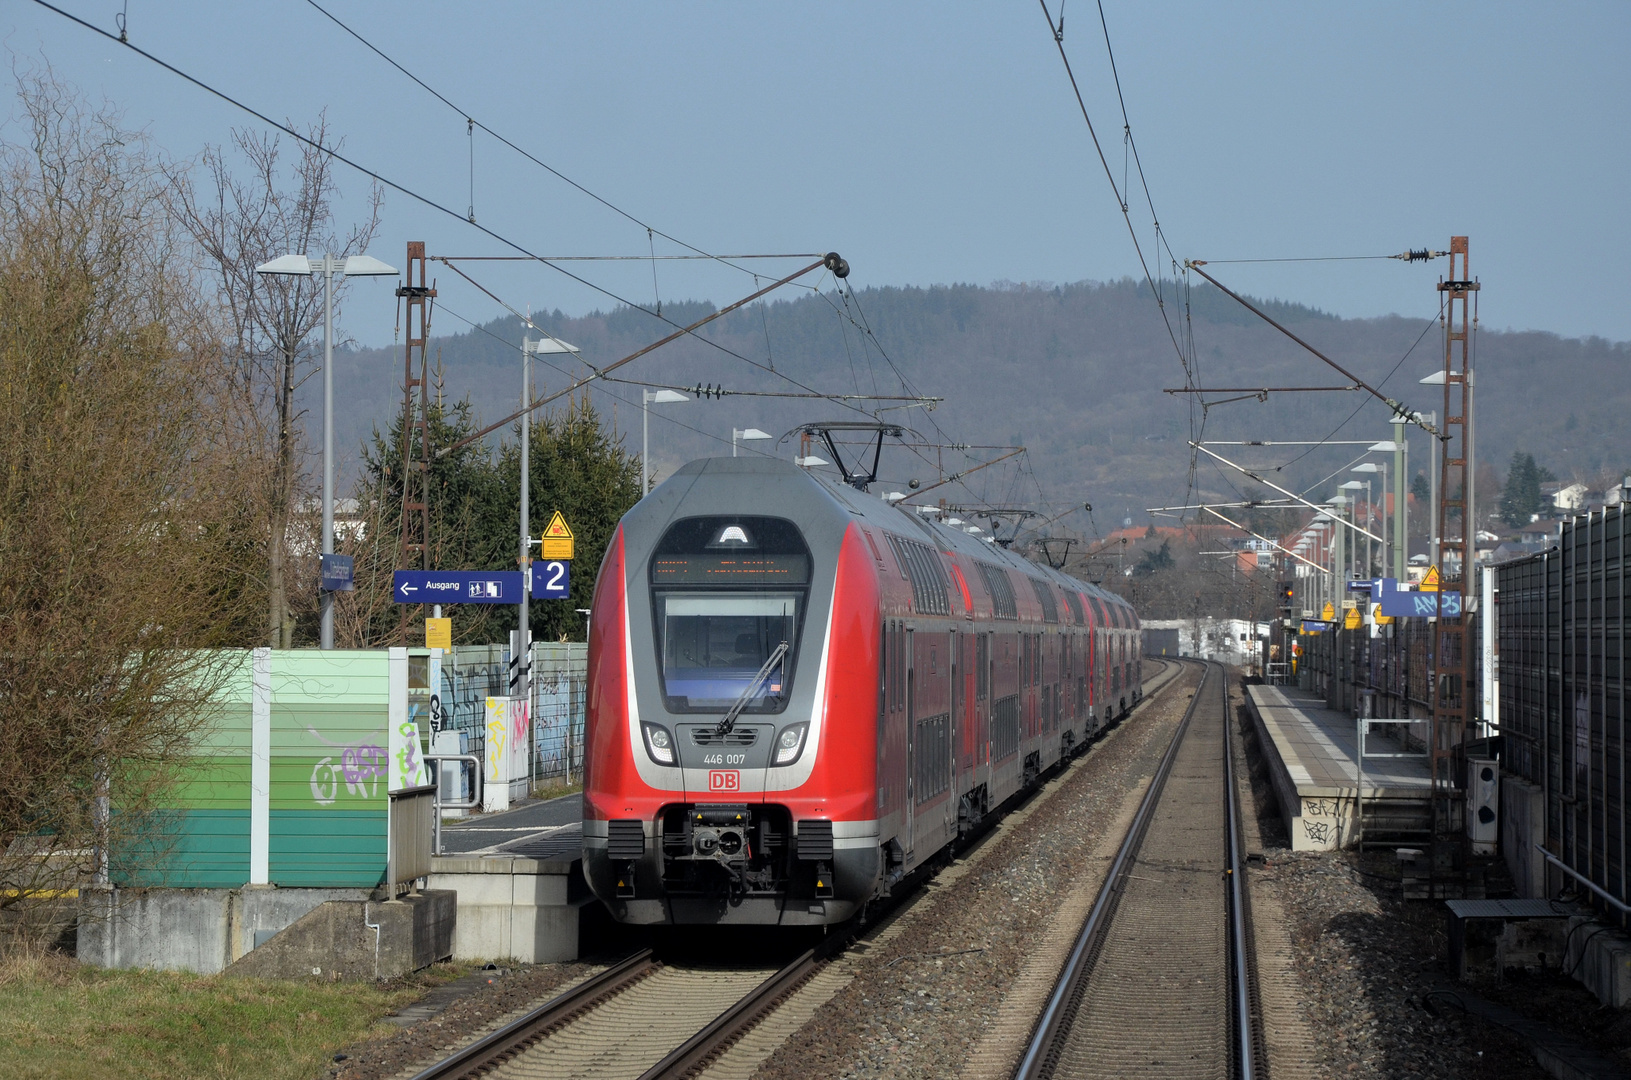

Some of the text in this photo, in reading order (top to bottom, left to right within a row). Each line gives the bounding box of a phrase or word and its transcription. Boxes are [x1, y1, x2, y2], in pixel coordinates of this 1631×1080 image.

[546, 562, 565, 590] 2
[426, 581, 460, 590] Ausgang
[1374, 579, 1382, 597] 1
[704, 754, 745, 764] 446 007
[712, 773, 737, 789] DB
